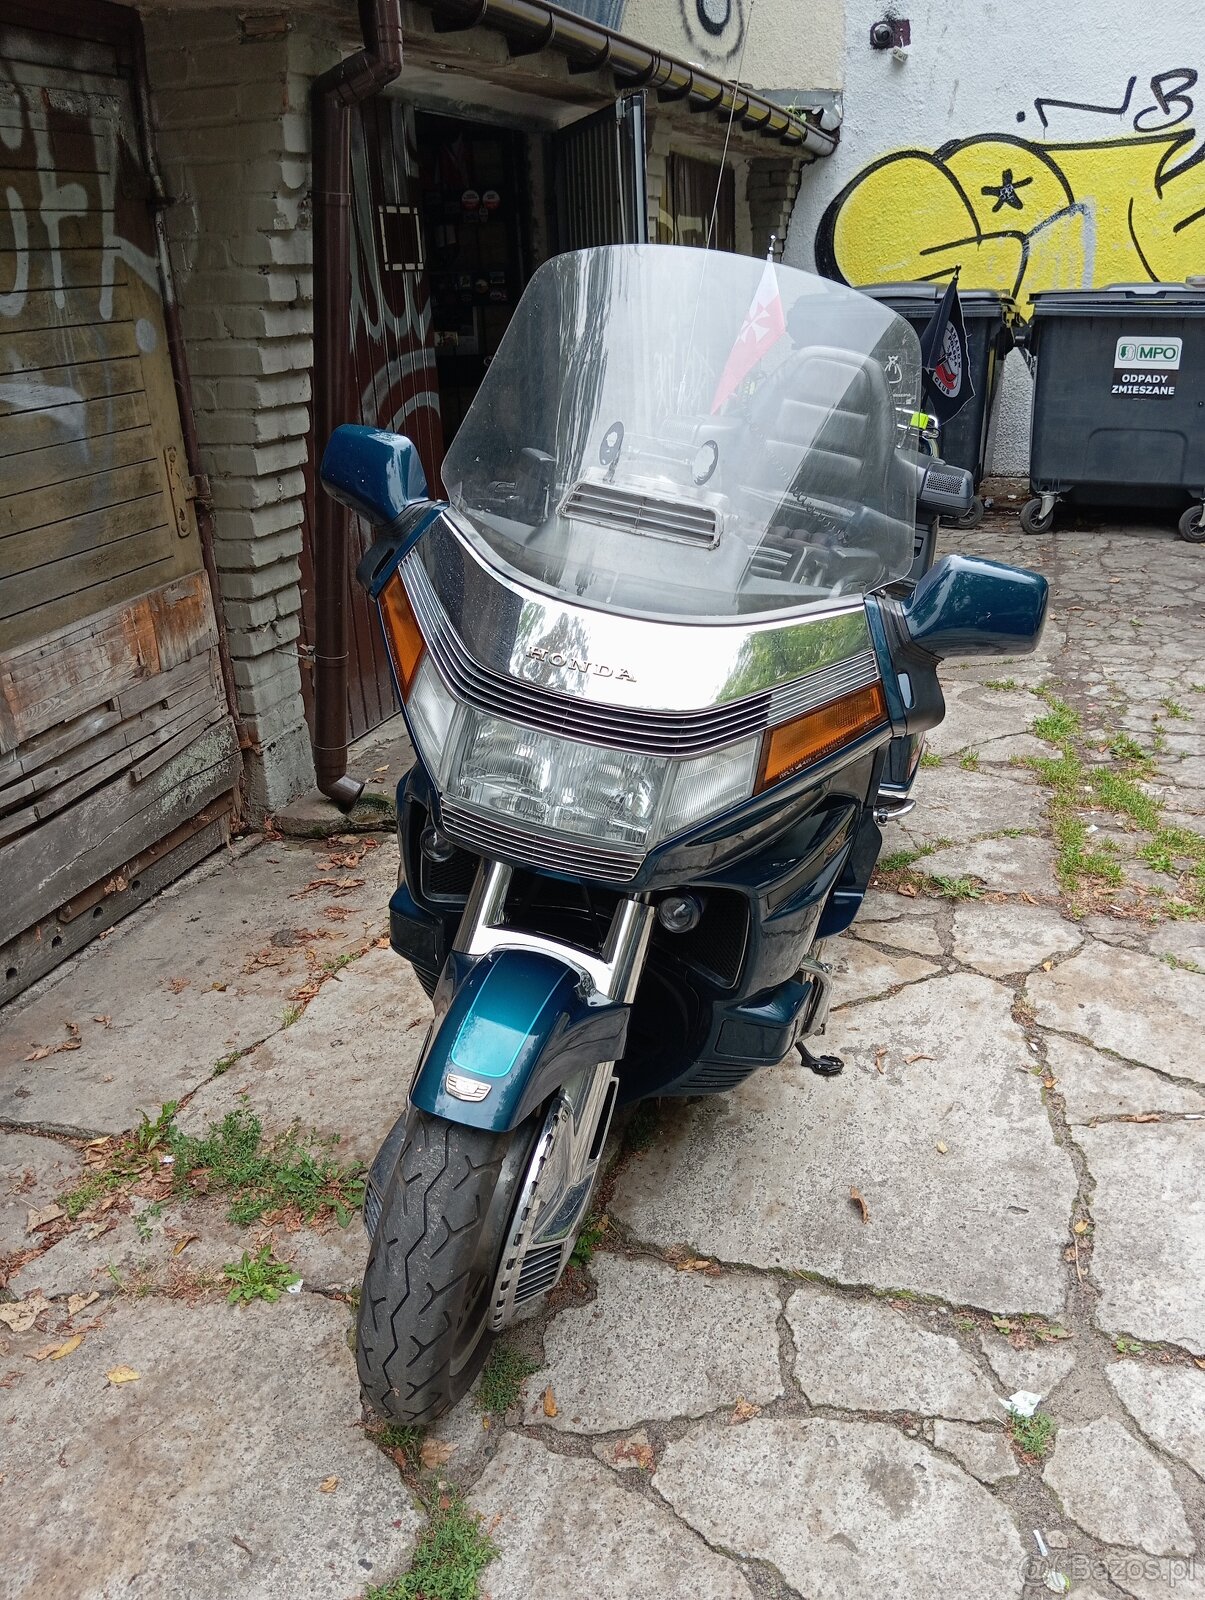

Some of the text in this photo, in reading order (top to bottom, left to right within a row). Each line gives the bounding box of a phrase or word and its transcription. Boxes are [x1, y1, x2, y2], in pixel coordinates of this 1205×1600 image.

[1139, 346, 1176, 360] MPO
[935, 377, 950, 394] CLUB
[1121, 374, 1168, 384] ODPADY
[1111, 384, 1176, 395] ZMIESZANE
[525, 645, 638, 683] HONDA
